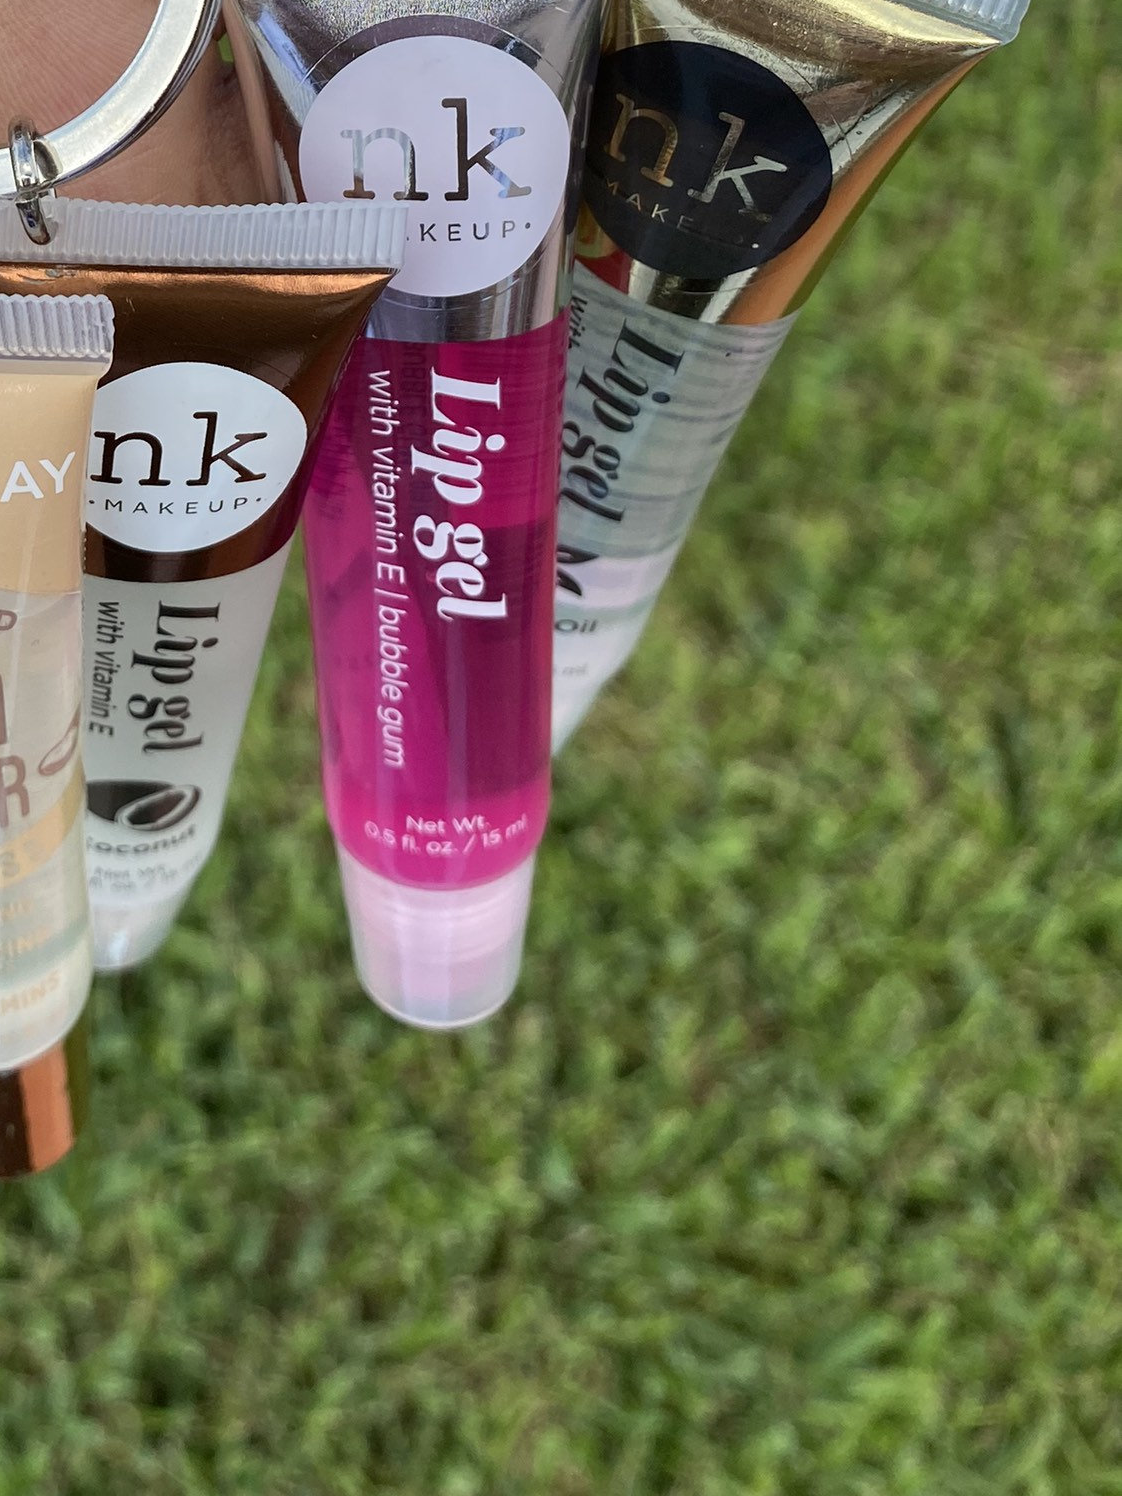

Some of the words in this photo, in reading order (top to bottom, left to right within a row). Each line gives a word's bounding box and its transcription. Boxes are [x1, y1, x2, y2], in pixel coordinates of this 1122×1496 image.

[340, 97, 532, 201] nk
[605, 93, 788, 223] nk
[405, 220, 516, 243] KEUP
[368, 370, 401, 436] with
[576, 318, 686, 433] Lip
[89, 411, 269, 487] nk
[410, 366, 506, 504] Lip
[372, 446, 405, 554] vitamin
[559, 421, 627, 522] gel
[377, 561, 406, 585] E
[413, 514, 508, 622] gel
[96, 601, 126, 645] with
[130, 600, 221, 685] Lip
[378, 604, 409, 702] bubble
[90, 650, 122, 718] vitamin
[88, 721, 115, 738] E
[128, 693, 205, 754] gel
[377, 704, 406, 769] gum
[405, 814, 446, 835] Net
[482, 827, 502, 848] 15
[505, 812, 528, 839] ml
